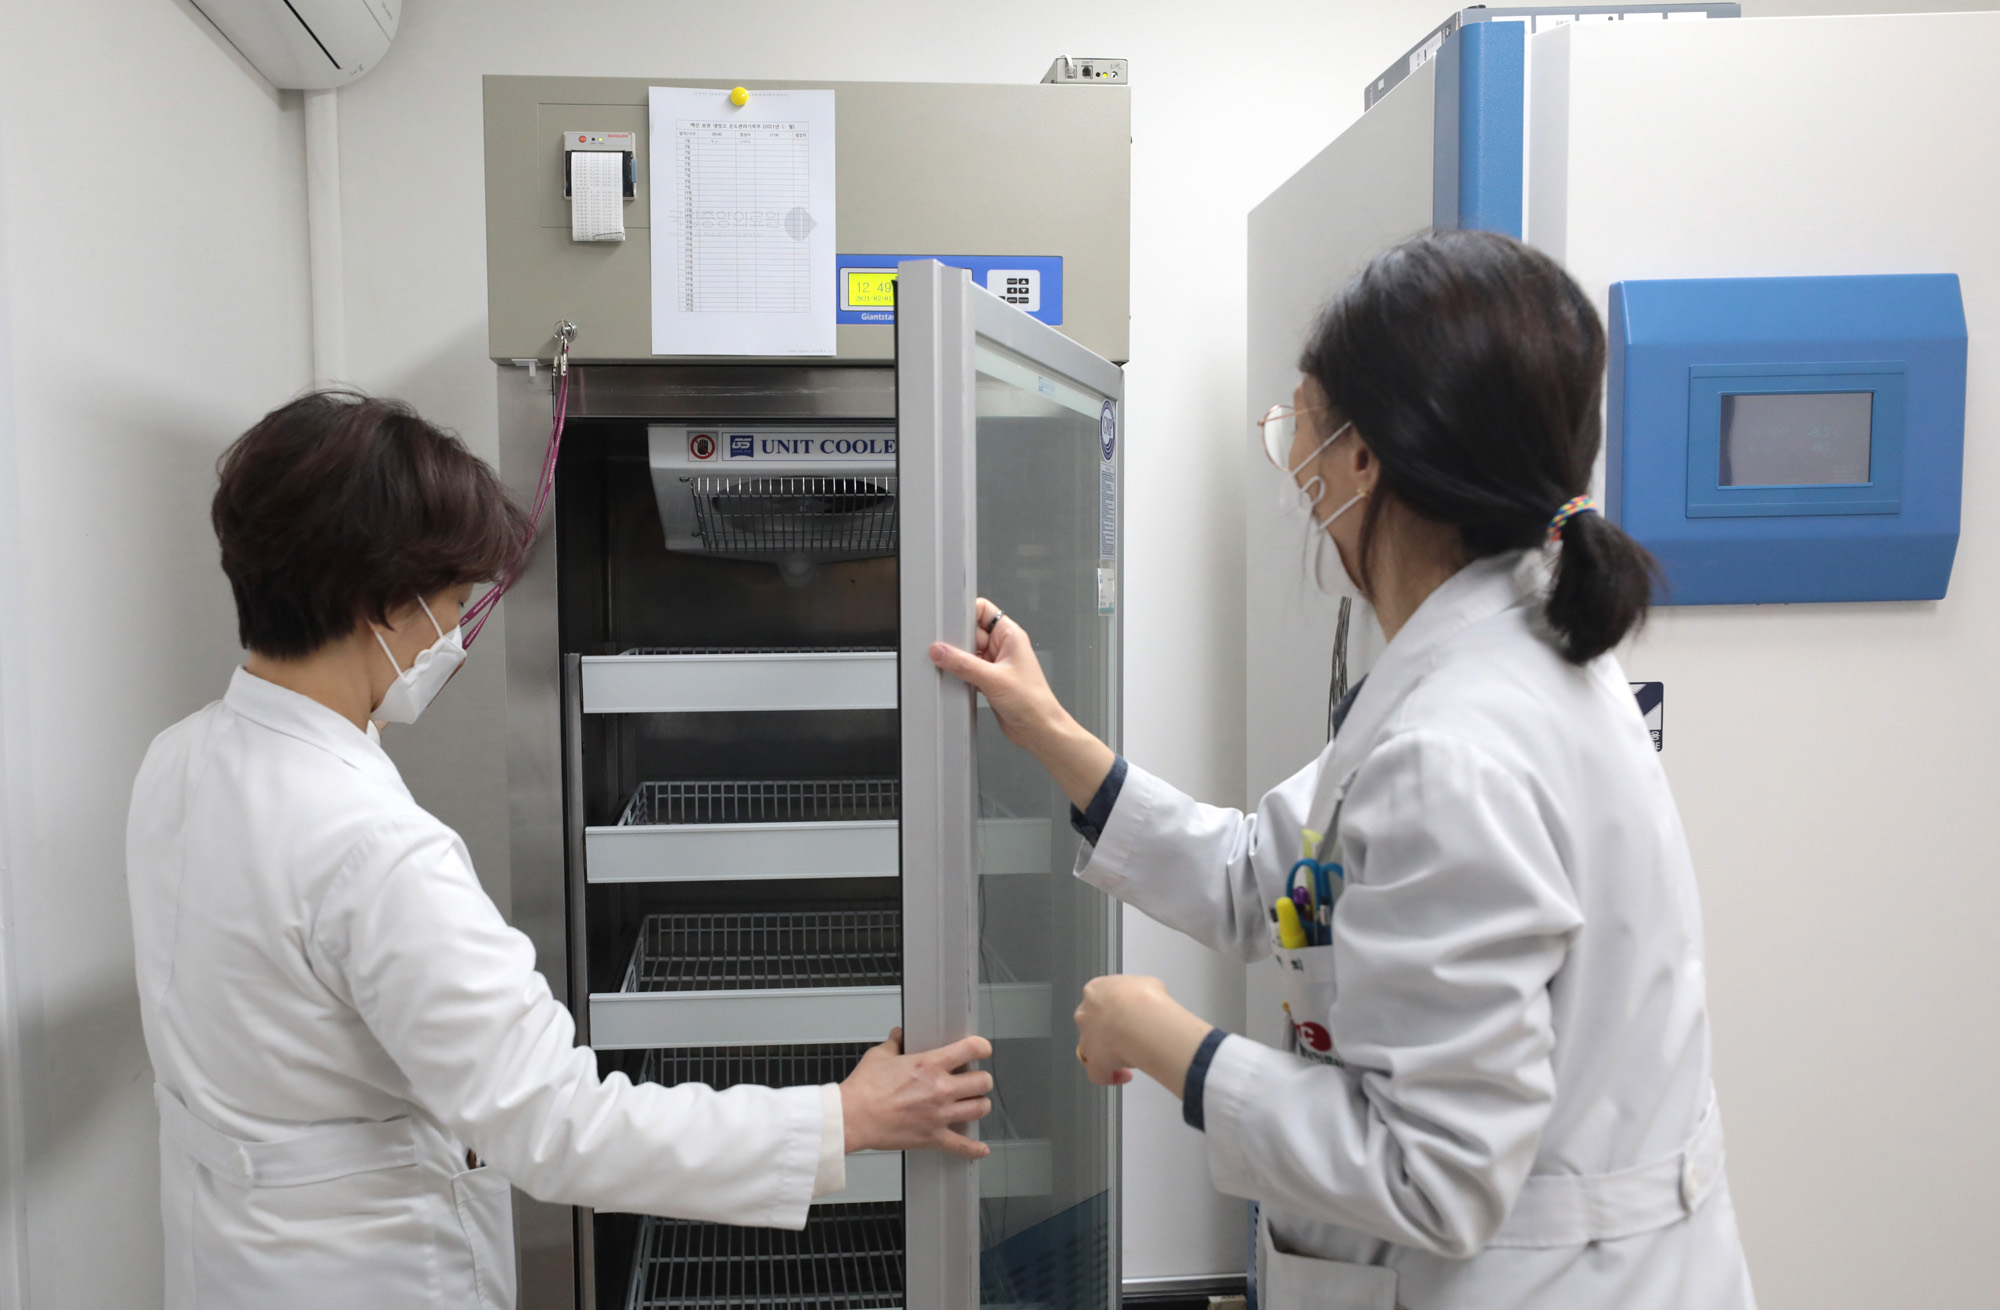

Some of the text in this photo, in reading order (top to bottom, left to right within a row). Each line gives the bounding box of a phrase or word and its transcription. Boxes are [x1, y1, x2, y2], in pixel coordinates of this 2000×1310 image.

[857, 281, 892, 293] 12 49
[762, 439, 896, 455] UNIT COOLE
